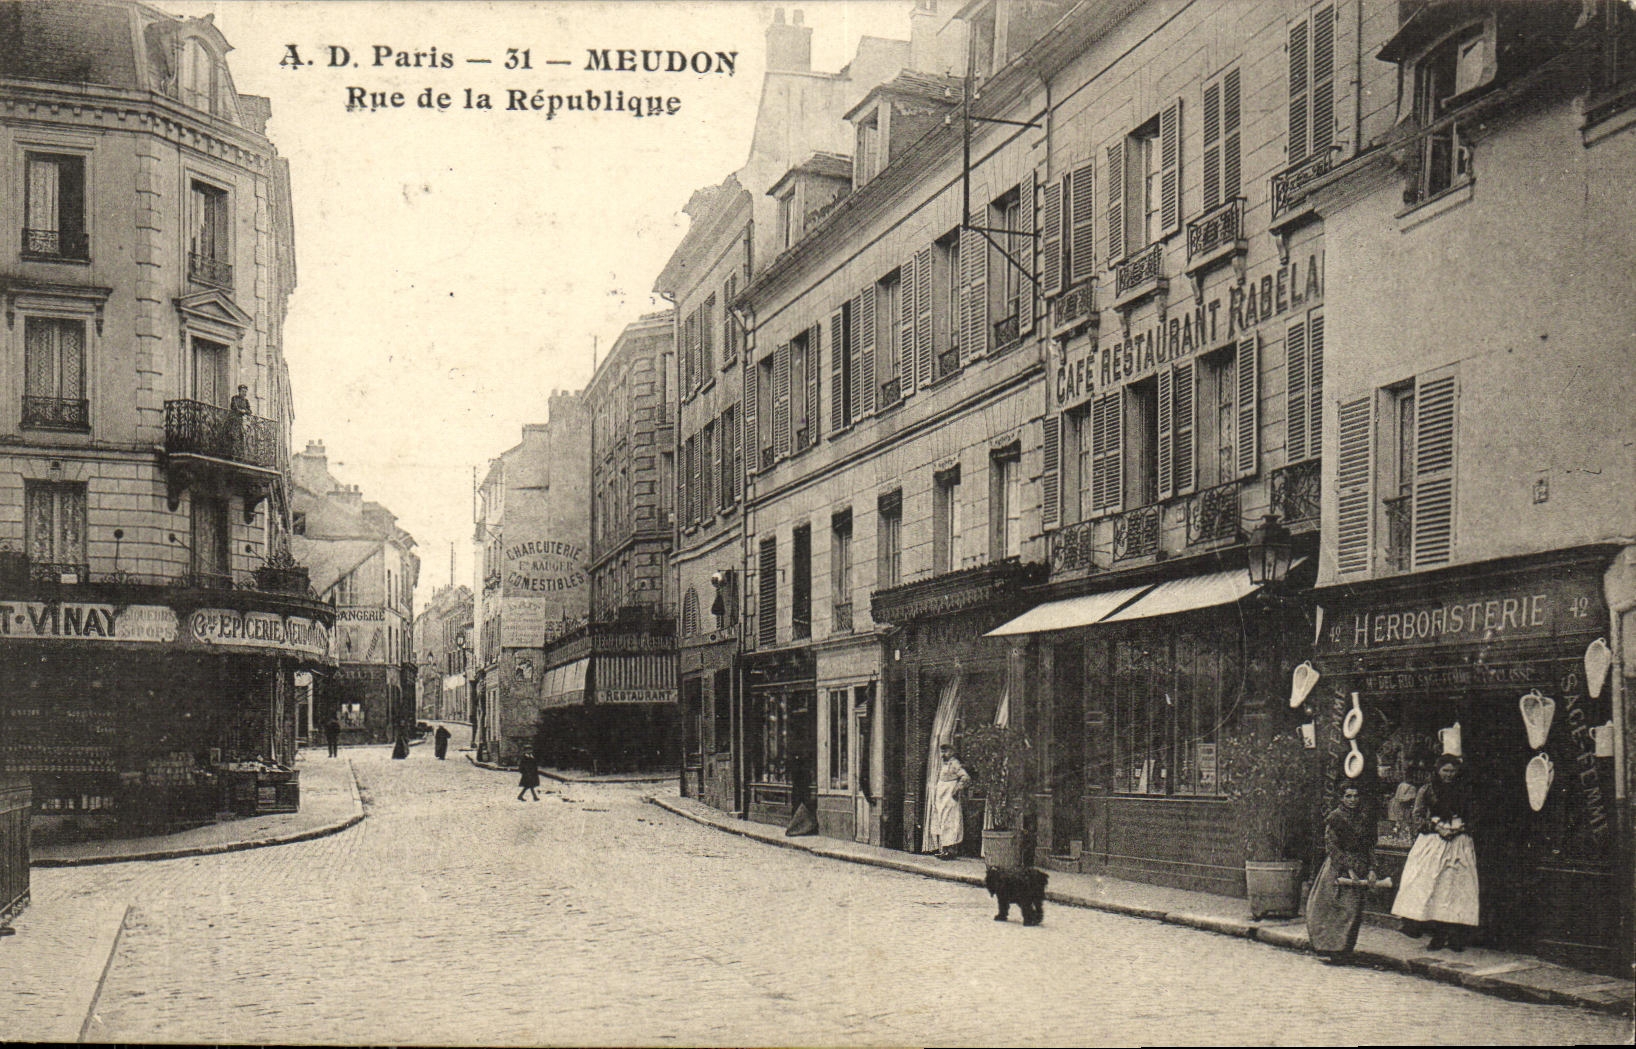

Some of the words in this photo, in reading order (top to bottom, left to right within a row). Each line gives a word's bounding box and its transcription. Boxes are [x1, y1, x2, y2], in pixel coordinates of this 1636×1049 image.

[1101, 299, 1220, 386] RESTAURANT
[505, 540, 582, 561] CHARCUTERIE
[507, 572, 585, 592] COMESTIBLES
[1568, 596, 1589, 618] 42
[27, 606, 118, 637] VINAY
[606, 690, 672, 701] RESTAURANT
